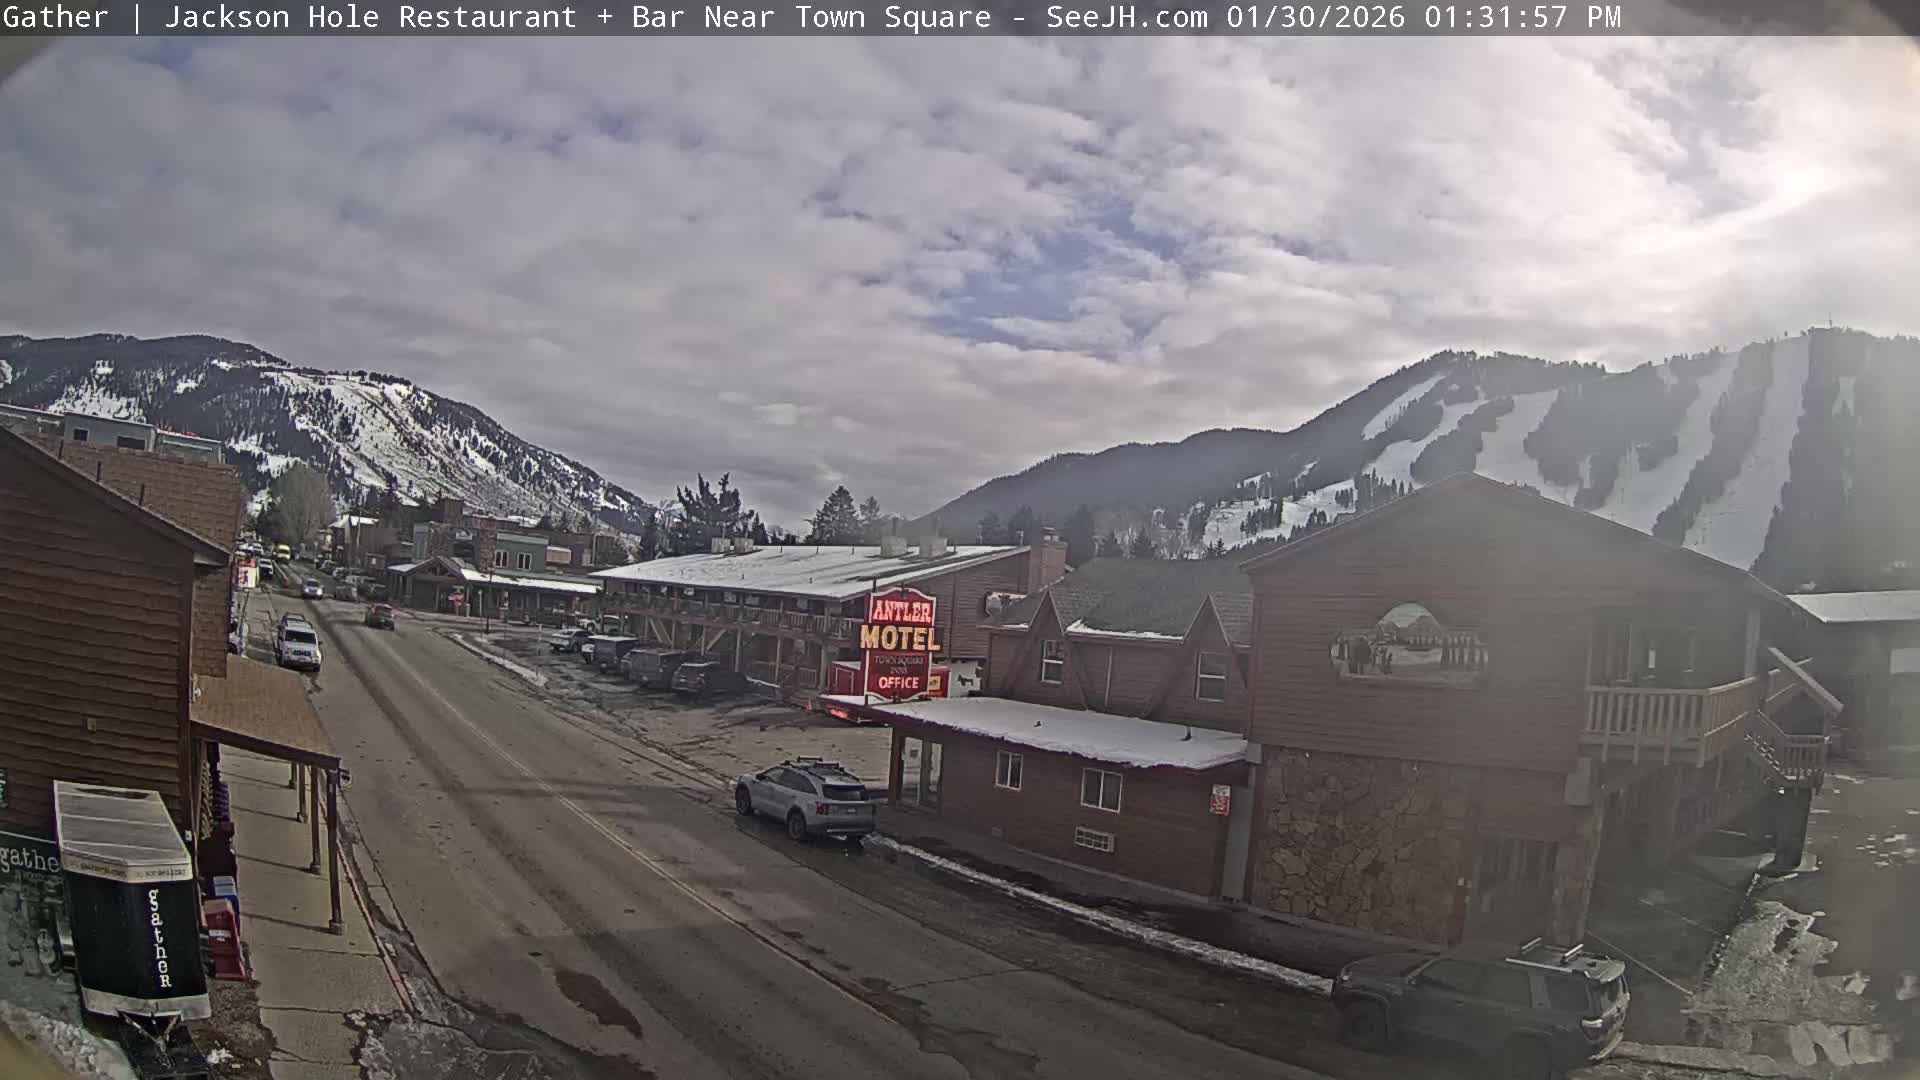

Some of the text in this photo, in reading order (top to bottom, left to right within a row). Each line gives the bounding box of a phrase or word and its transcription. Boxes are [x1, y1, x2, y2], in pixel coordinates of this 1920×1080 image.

[872, 600, 931, 623] ANTLER
[860, 625, 941, 650] MOTEL
[879, 677, 920, 689] OFFICE
[0, 847, 60, 873] gathe
